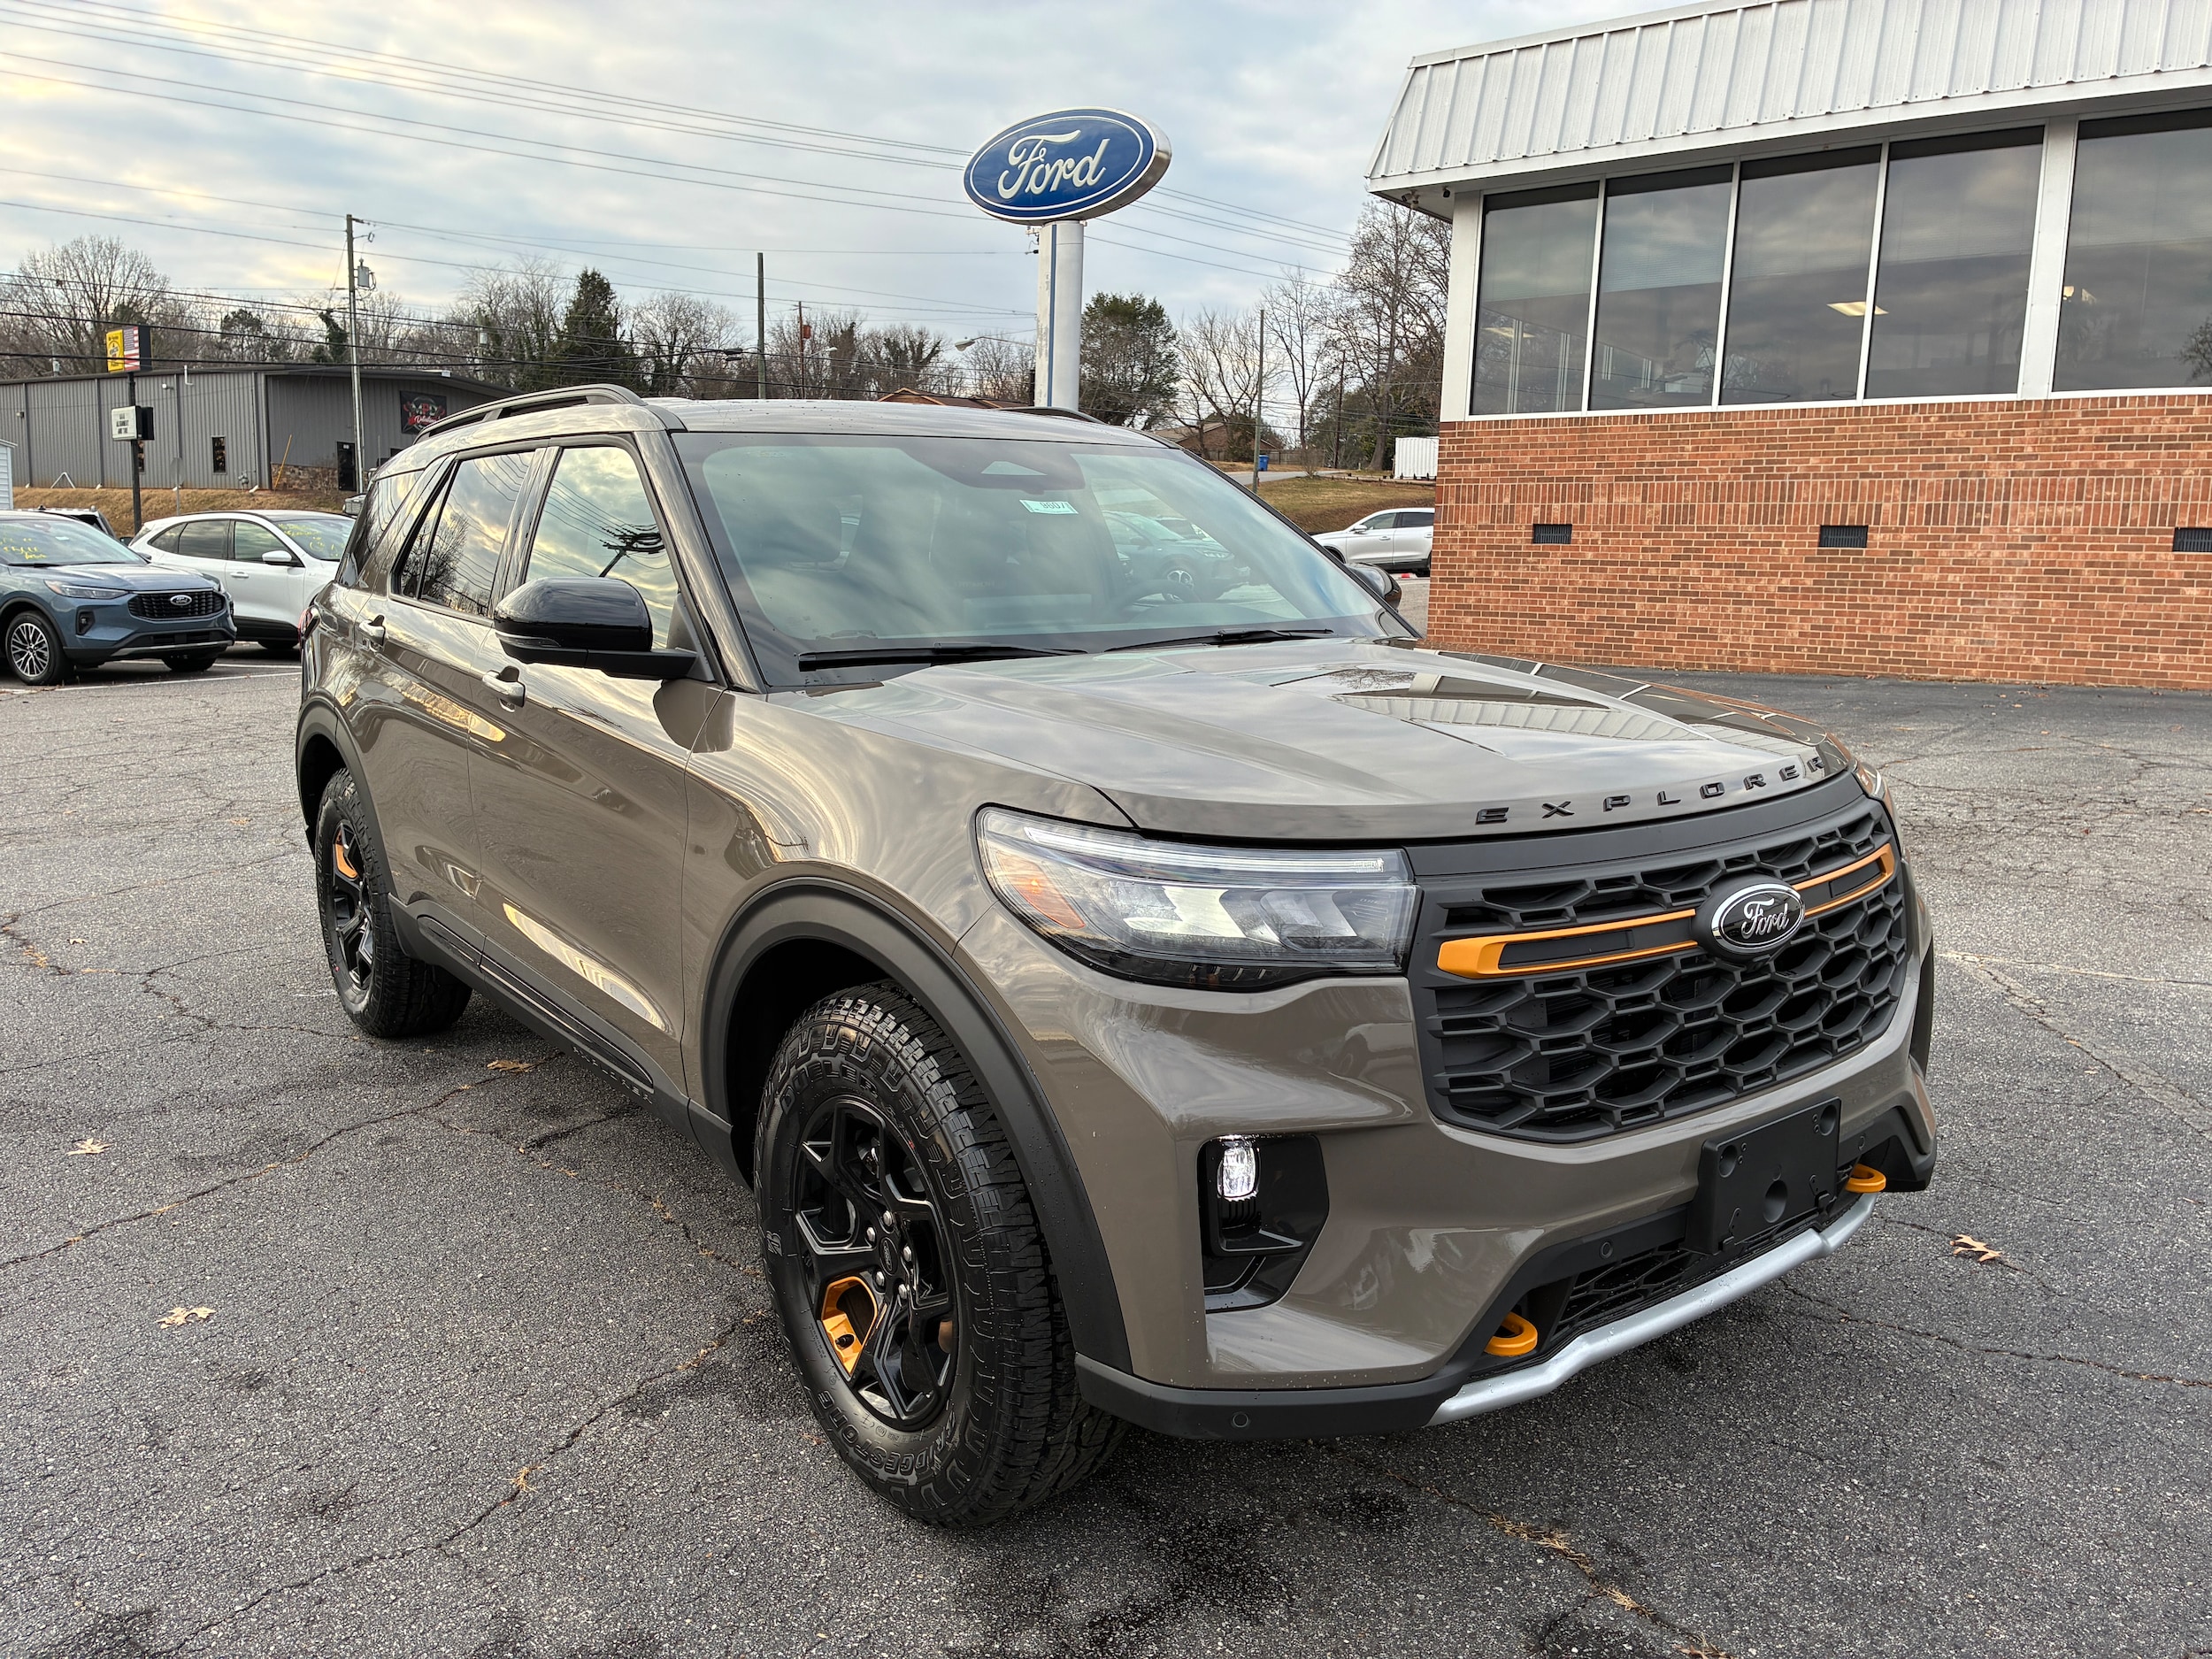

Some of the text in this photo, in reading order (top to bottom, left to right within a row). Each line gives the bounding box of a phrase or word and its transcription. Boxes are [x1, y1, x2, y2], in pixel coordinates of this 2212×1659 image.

[997, 130, 1110, 199] Ford
[1476, 757, 1825, 825] EXPLORER
[1740, 897, 1789, 940] Ford
